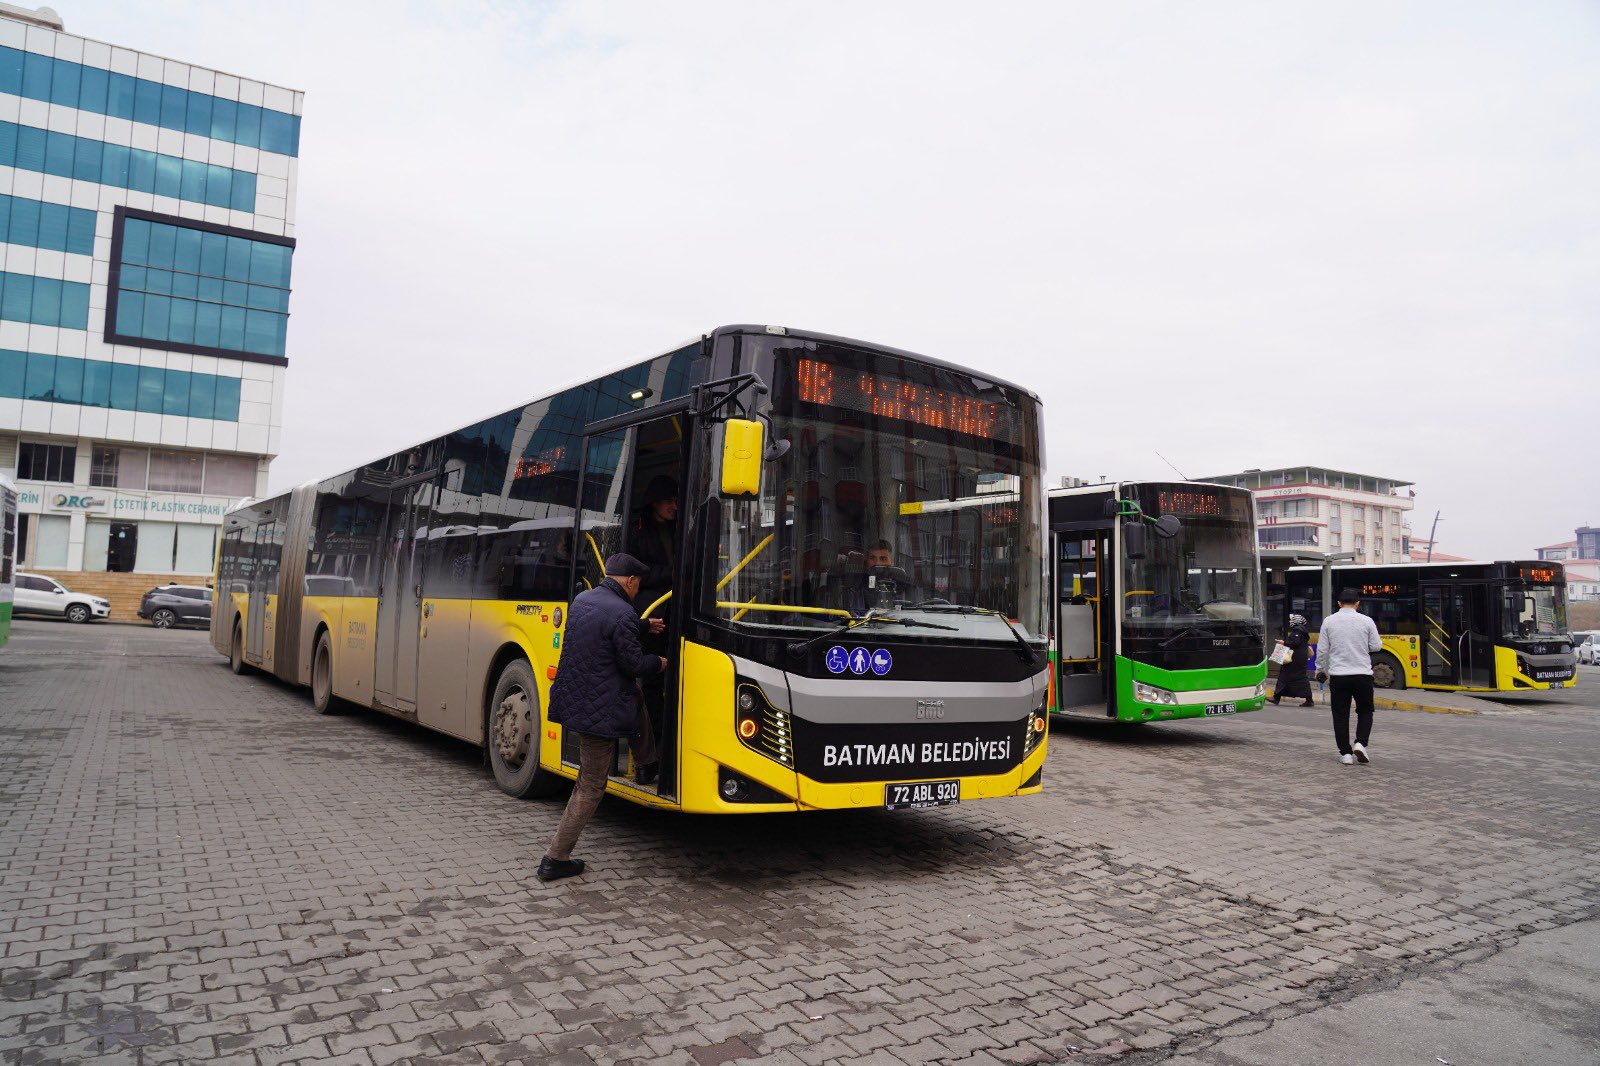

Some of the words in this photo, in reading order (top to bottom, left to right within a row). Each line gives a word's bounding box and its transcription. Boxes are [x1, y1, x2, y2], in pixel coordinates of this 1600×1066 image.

[113, 498, 148, 510] ESTETİK
[151, 501, 185, 513] PLASTİK
[188, 503, 220, 515] CERRAHİ
[823, 743, 916, 767] BATMAN
[921, 736, 1011, 762] BELEDİYESİ
[894, 786, 910, 803] 72
[912, 784, 935, 802] ABL
[937, 782, 958, 800] 920
